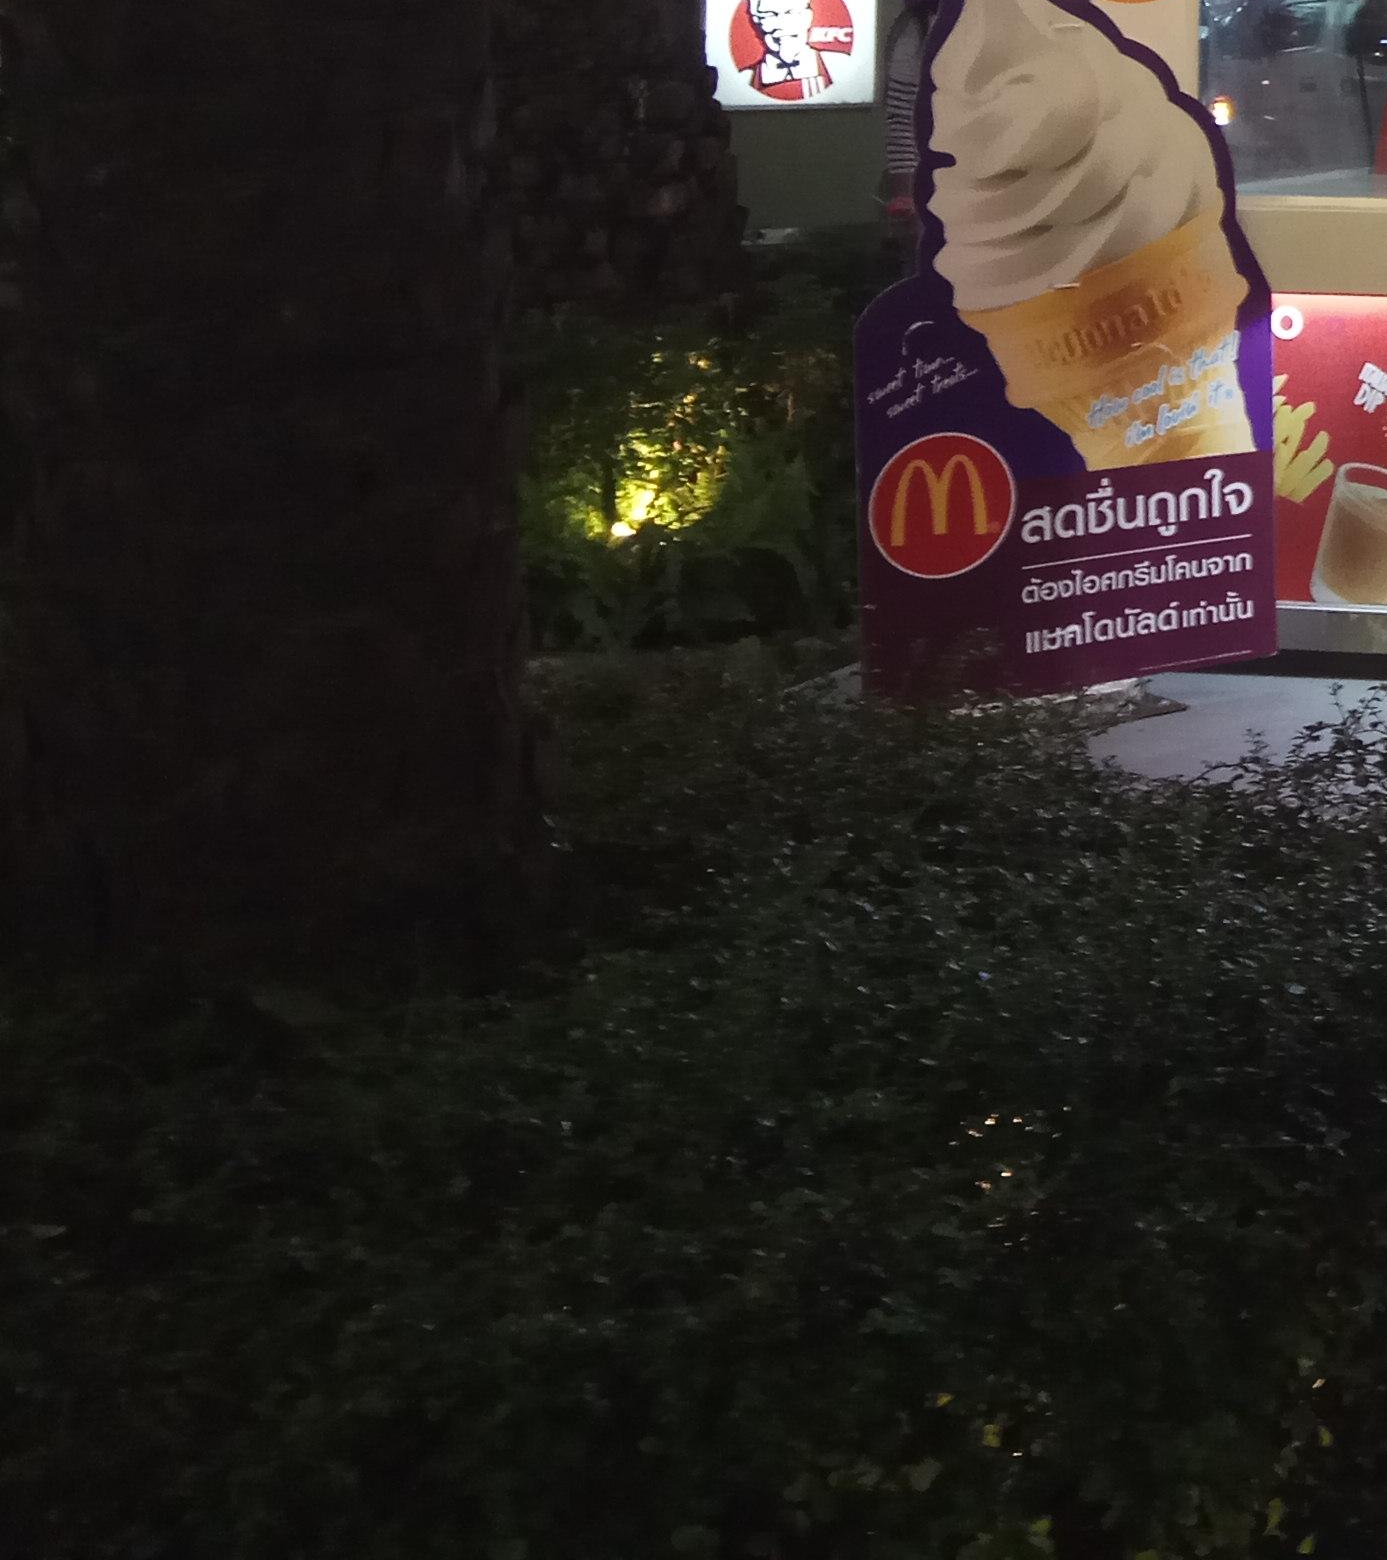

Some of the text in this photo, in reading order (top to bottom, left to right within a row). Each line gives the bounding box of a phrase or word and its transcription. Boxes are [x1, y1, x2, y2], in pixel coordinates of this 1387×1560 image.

[1021, 468, 1253, 543] สดชื่นถูกใจ
[1021, 551, 1253, 604] ต้องไอศกรีมโคนจาก
